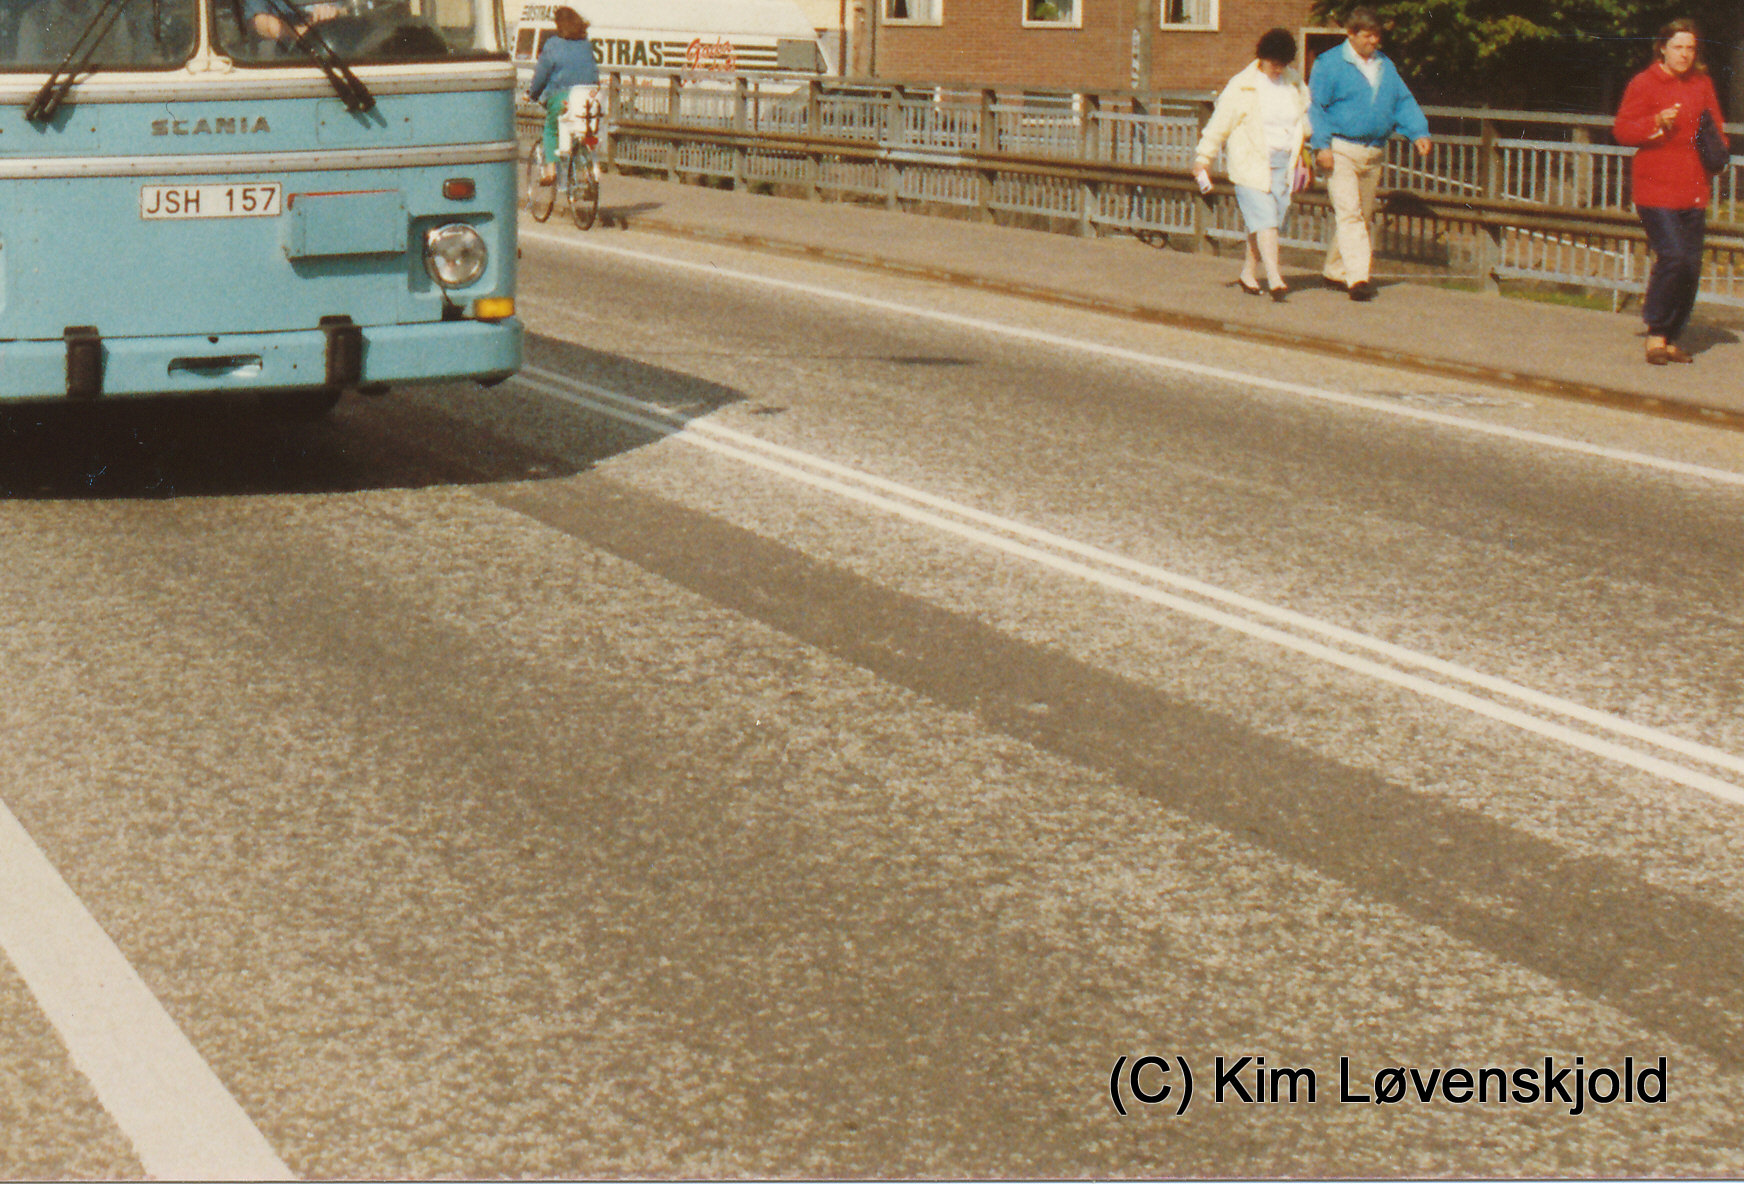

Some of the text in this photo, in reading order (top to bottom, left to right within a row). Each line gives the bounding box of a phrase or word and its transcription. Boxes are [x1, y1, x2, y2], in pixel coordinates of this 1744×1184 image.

[591, 38, 663, 67] STRAS
[151, 116, 271, 136] SCANIA
[146, 187, 277, 215] JSH 157
